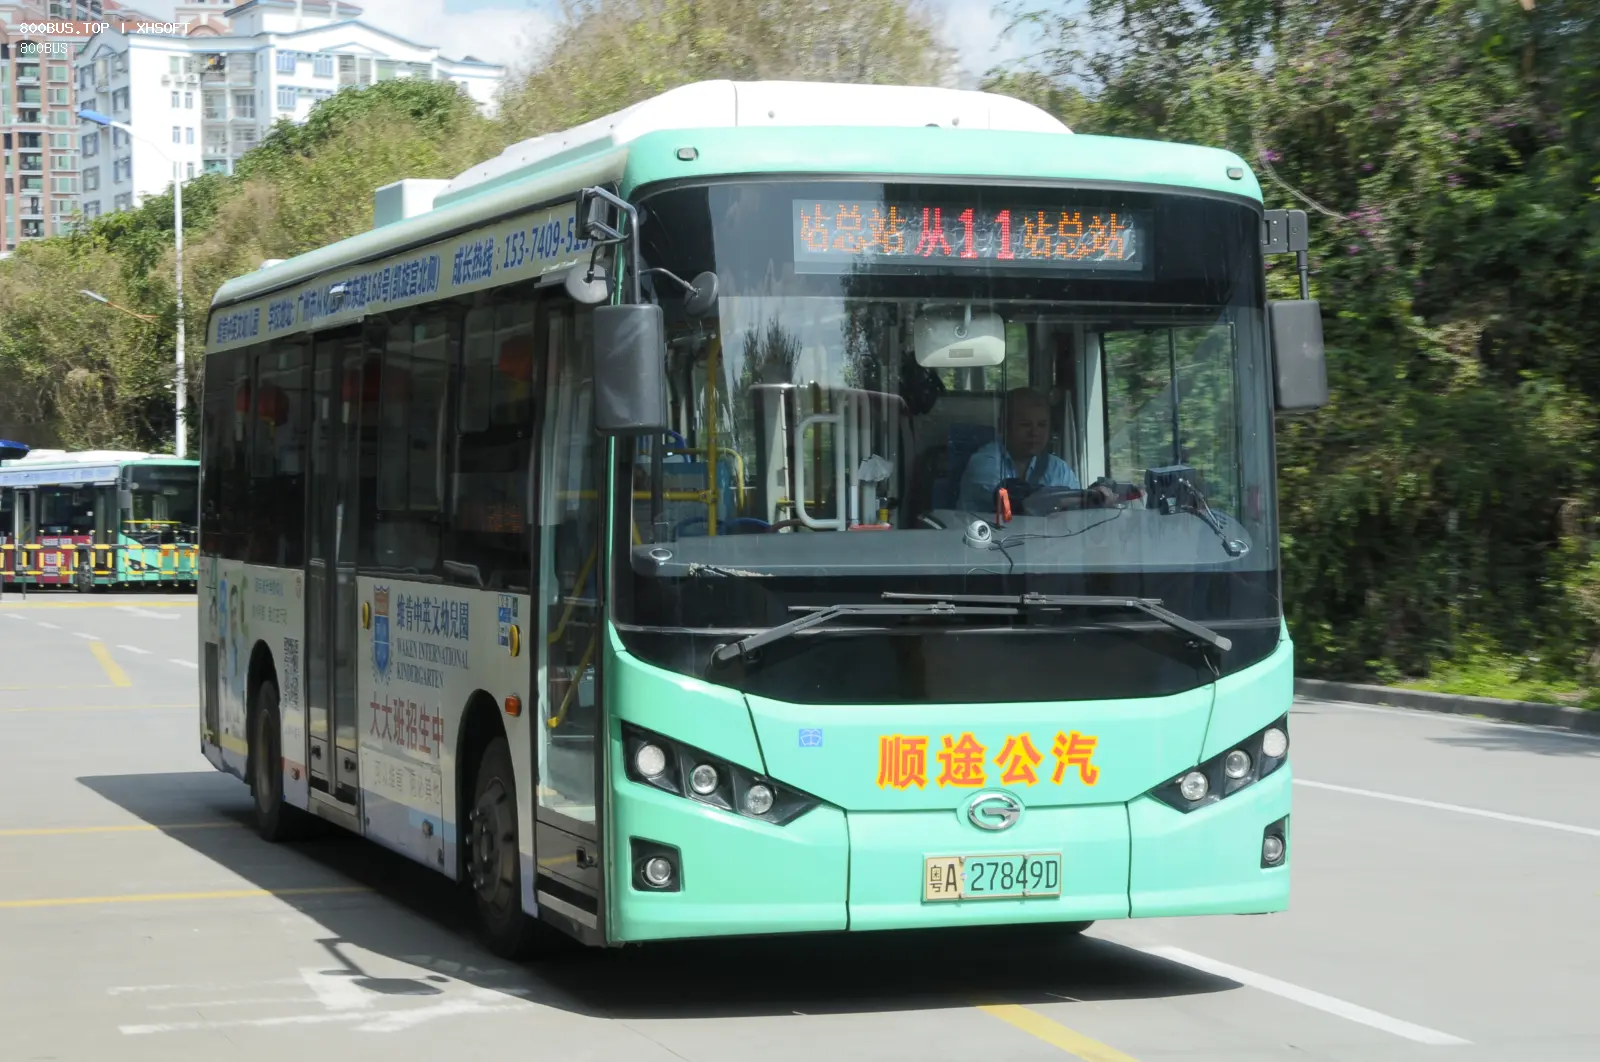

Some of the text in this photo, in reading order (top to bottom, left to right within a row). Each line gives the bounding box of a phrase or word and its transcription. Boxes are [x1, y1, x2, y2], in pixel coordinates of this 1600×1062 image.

[418, 641, 470, 671] INTERNATIONAL
[396, 661, 444, 689] KINDERGARTEN
[370, 691, 444, 759] 大大班招生中
[875, 730, 1101, 791] 顺途公汽
[970, 860, 1058, 891] 27849D
